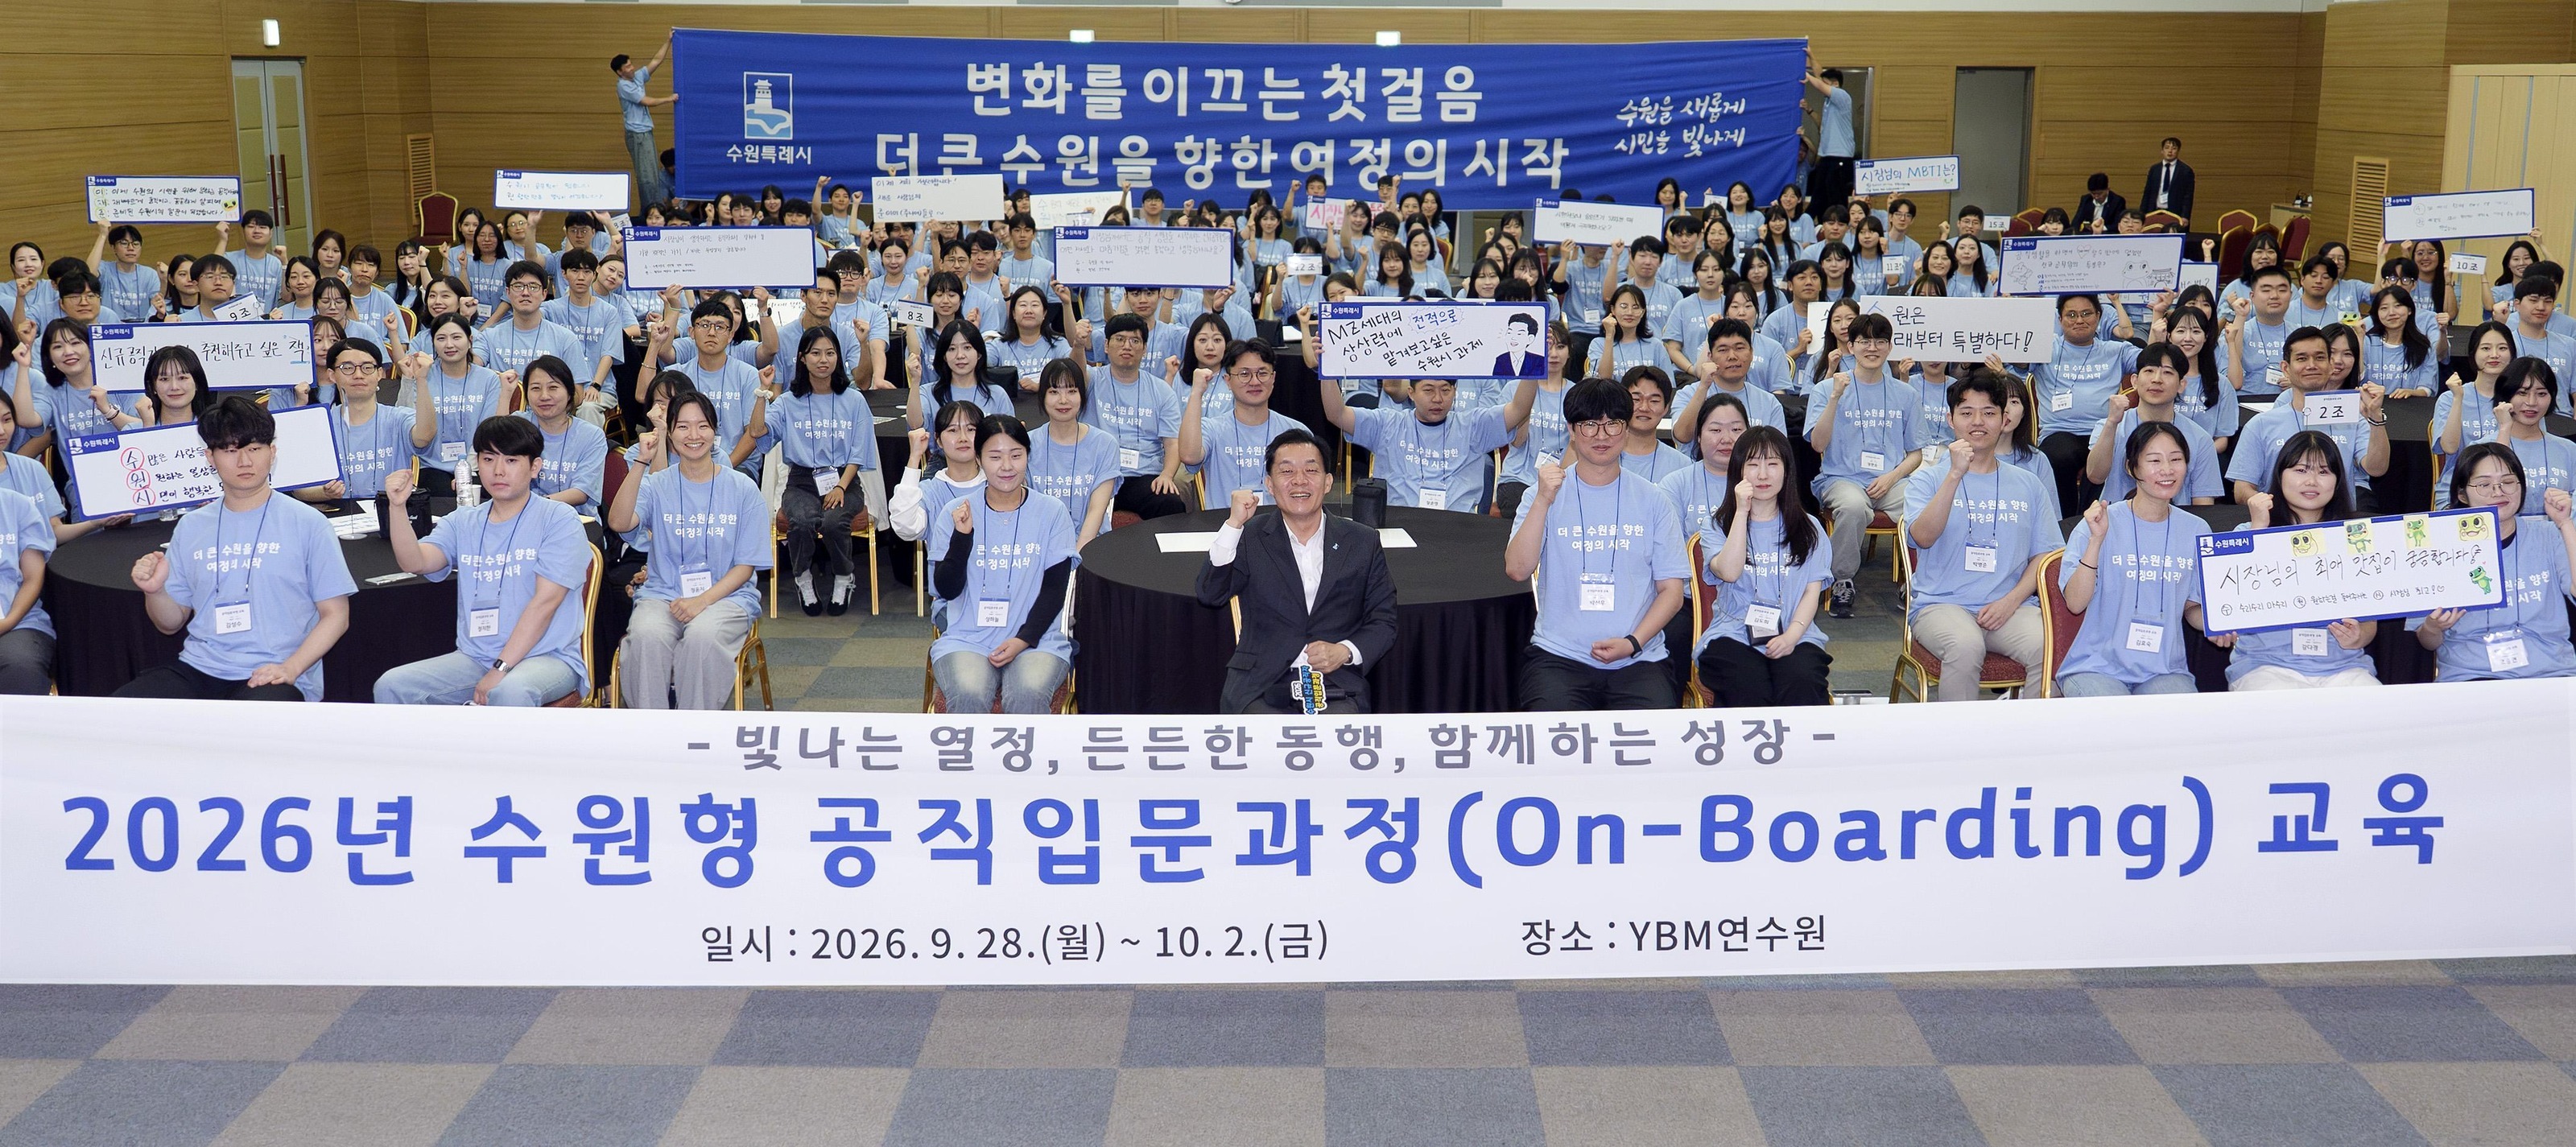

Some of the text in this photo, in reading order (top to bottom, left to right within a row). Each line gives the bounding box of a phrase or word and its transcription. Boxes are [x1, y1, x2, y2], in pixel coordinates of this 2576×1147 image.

[967, 62, 1482, 122] 변화를 이끄는 첫걸음
[1616, 93, 1746, 127] 수원을 새롭게
[1614, 123, 1745, 157] 시민을 빛나게
[726, 144, 811, 164] 수원특례시
[877, 133, 1569, 190] 더 큰 수원을 향한 여정의 시작
[1861, 163, 1956, 183] 시장님의 MBTI는?
[1333, 306, 1360, 314] 수원특례시
[103, 328, 130, 336] 수원특례시
[1327, 309, 1458, 345] MZ세대의 전적으로
[200, 341, 256, 362] 추천해주고
[260, 340, 283, 358] 싶은
[1343, 327, 1403, 363] 상상력에
[1951, 331, 2033, 354] 특별하다!
[83, 437, 116, 448] 수원특례시
[147, 452, 167, 466] 많은
[155, 471, 184, 483] 원하는
[183, 483, 217, 497] 행복한
[1954, 499, 1963, 508] 더
[1979, 499, 2008, 510] 수원을
[2011, 500, 2029, 512] 향한
[663, 514, 673, 524] 더
[675, 514, 685, 525] 큰
[718, 513, 737, 525] 향한
[1998, 513, 2019, 523] 시작
[675, 526, 725, 538] 여정의 시작
[1558, 523, 1644, 537] 더 큰 수원을 향한
[193, 542, 281, 560] 더 큰 수원을 향한
[976, 544, 986, 555] 큰
[991, 543, 1022, 555] 수원을
[1571, 538, 1630, 552] 여정의 시작
[2215, 537, 2250, 549] 수원특례시
[206, 556, 262, 573] 여정의 시작
[460, 553, 471, 565] 더
[473, 554, 483, 567] 큰
[514, 547, 537, 561] 향한
[976, 556, 1031, 571] 여정의 시작
[2112, 555, 2123, 566] 더
[2126, 554, 2137, 566] 큰
[2140, 554, 2174, 567] 수원을
[505, 563, 522, 580] 시작
[2126, 570, 2182, 584] 여정의 시작
[2219, 559, 2301, 596] 시장님의
[2314, 554, 2344, 580] 최애
[2352, 550, 2397, 577] 맛집이
[2239, 601, 2264, 613] 수리수리
[2267, 600, 2288, 611] 마수리
[2389, 589, 2411, 598] 시장님
[2518, 589, 2542, 604] 시작
[737, 719, 1790, 775] 빛나는 열정, 든든한 동행, 함께하는 성장
[62, 773, 2445, 889] 2026년 수원형 공직입문과정(On-Boarding) 교육
[1521, 914, 1825, 956] 장소 YBM연수원
[701, 925, 771, 963] 일시
